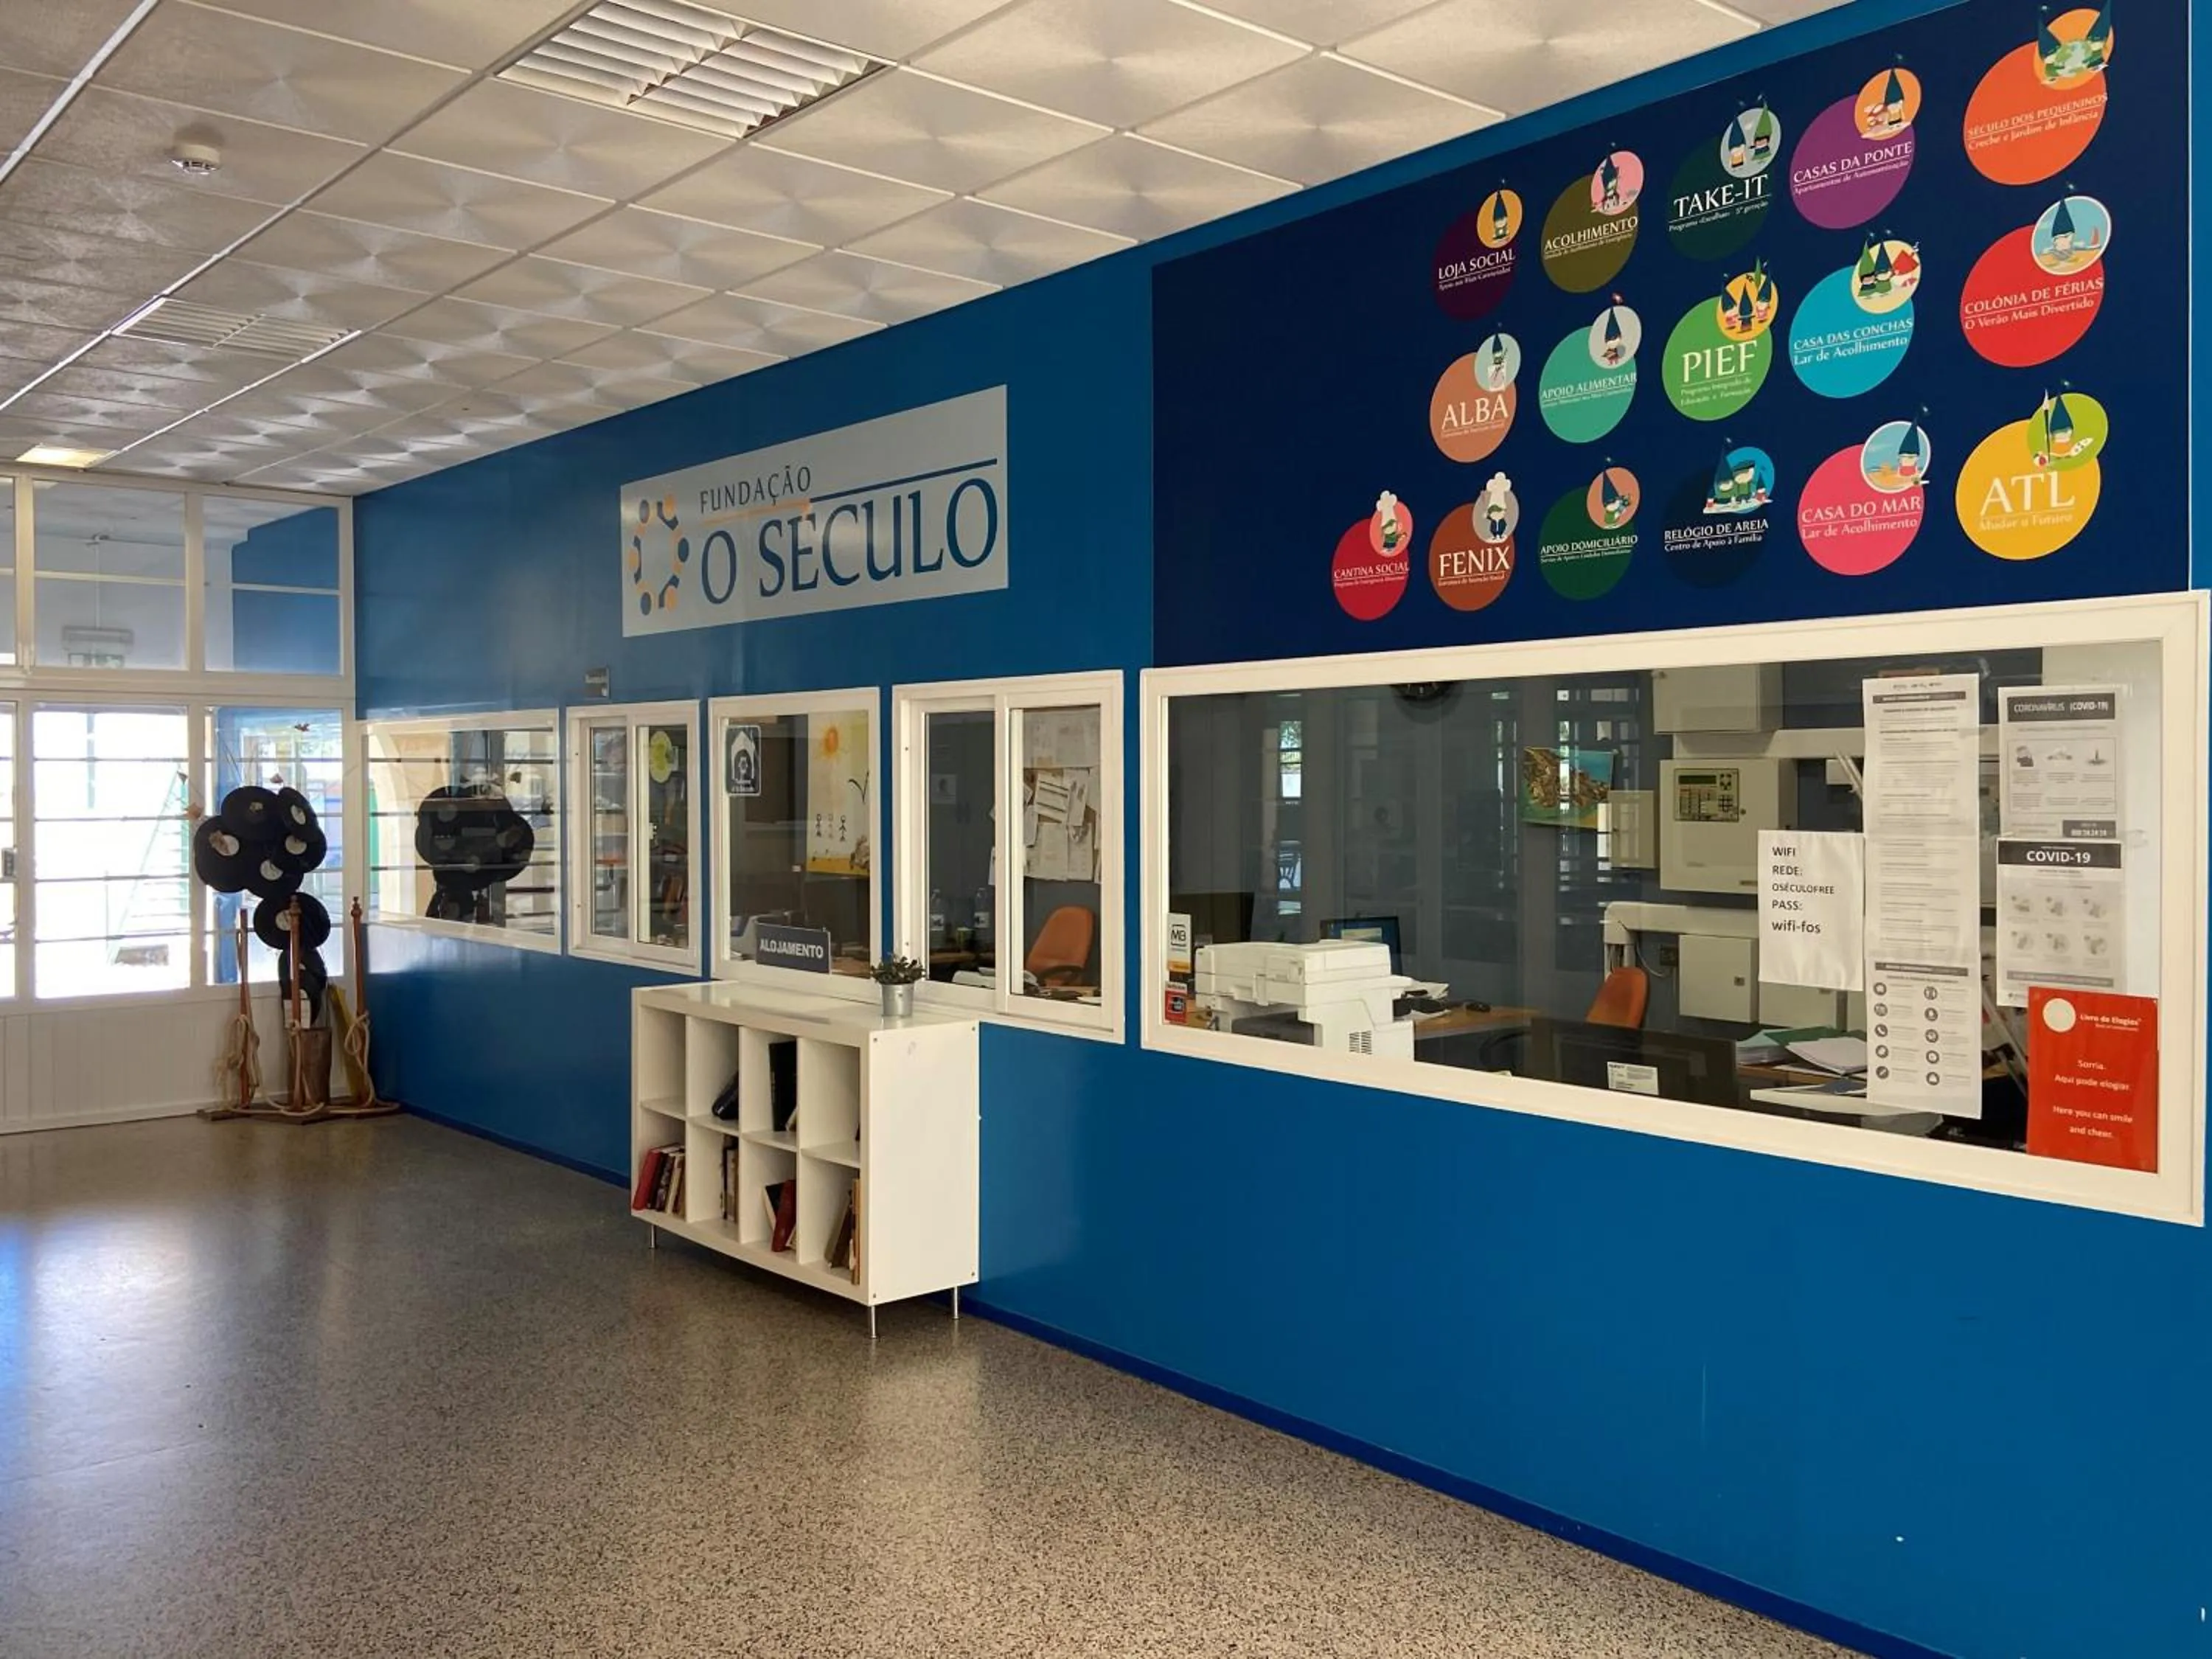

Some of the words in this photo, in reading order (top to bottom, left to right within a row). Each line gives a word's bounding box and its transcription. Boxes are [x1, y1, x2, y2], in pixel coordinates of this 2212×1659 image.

[2012, 113, 2035, 125] DOS
[2037, 92, 2108, 118] PEQUENINOS
[1969, 135, 2000, 150] Creche
[2011, 126, 2042, 142] Jardim
[2045, 121, 2056, 131] de
[1793, 161, 1837, 183] CASAS
[1841, 156, 1860, 171] DA
[1865, 141, 1912, 164] PONTE
[1673, 174, 1768, 218] TAKE-IT
[1544, 216, 1638, 251] ACOLHIMENTO
[1439, 261, 1467, 279] LOJA
[1470, 248, 1516, 271] SOCIAL
[1965, 293, 2028, 314] COLÓNIA
[2031, 288, 2050, 302] DE
[2055, 277, 2104, 296] FÉRIAS
[1965, 320, 1975, 330] O
[1978, 315, 2008, 328] Verão
[2011, 310, 2038, 322] Mais
[2041, 298, 2094, 316] Divertido
[1793, 335, 1823, 350] CASA
[1827, 330, 1850, 344] DAS
[1853, 318, 1913, 338] CONCHAS
[1682, 340, 1757, 383] PIEF
[1793, 354, 1812, 365] Lar
[1816, 348, 1829, 361] de
[1834, 336, 1907, 358] Acolhimento
[1541, 385, 1574, 399] APOIO
[1578, 372, 1637, 392] ALIMENTAR
[1441, 394, 1509, 430] ALBA
[700, 465, 810, 514] FUNDAÇÃO
[1980, 470, 2076, 516] ATL
[1801, 506, 1845, 523] CASA
[1850, 501, 1877, 517] DO
[1882, 495, 1922, 513] MAR
[1664, 526, 1713, 540] RELÓGIO
[1716, 523, 1731, 535] DE
[1734, 518, 1769, 532] AREIA
[1802, 528, 1820, 539] Lar
[1824, 525, 1837, 537] de
[1841, 518, 1917, 535] Acolhimento
[1540, 543, 1569, 554] APOIO
[1571, 535, 1638, 551] DOMICILIÁRIO
[1664, 543, 1690, 552] Centro
[1692, 540, 1701, 549] de
[1703, 539, 1725, 549] Apoio
[701, 530, 736, 605] O
[1334, 566, 1373, 579] CANTINA
[1376, 561, 1409, 574] SOCIAL
[1439, 546, 1510, 577] FENIX
[1772, 846, 1795, 857] WIFI
[2026, 850, 2091, 863] COVID-19
[1772, 865, 1803, 876] REDE:
[1772, 899, 1803, 911] PASS:
[1171, 928, 1186, 942] MB
[1772, 919, 1820, 934] wifi-fos
[759, 938, 824, 959] ALOJAMENTO
[2054, 1074, 2074, 1085] Aqui
[2076, 1077, 2098, 1086] pode
[2053, 1105, 2073, 1116] Here
[2074, 1110, 2091, 1119] you
[2093, 1112, 2108, 1120] can
[2110, 1114, 2133, 1124] smile
[2069, 1126, 2086, 1135] and
